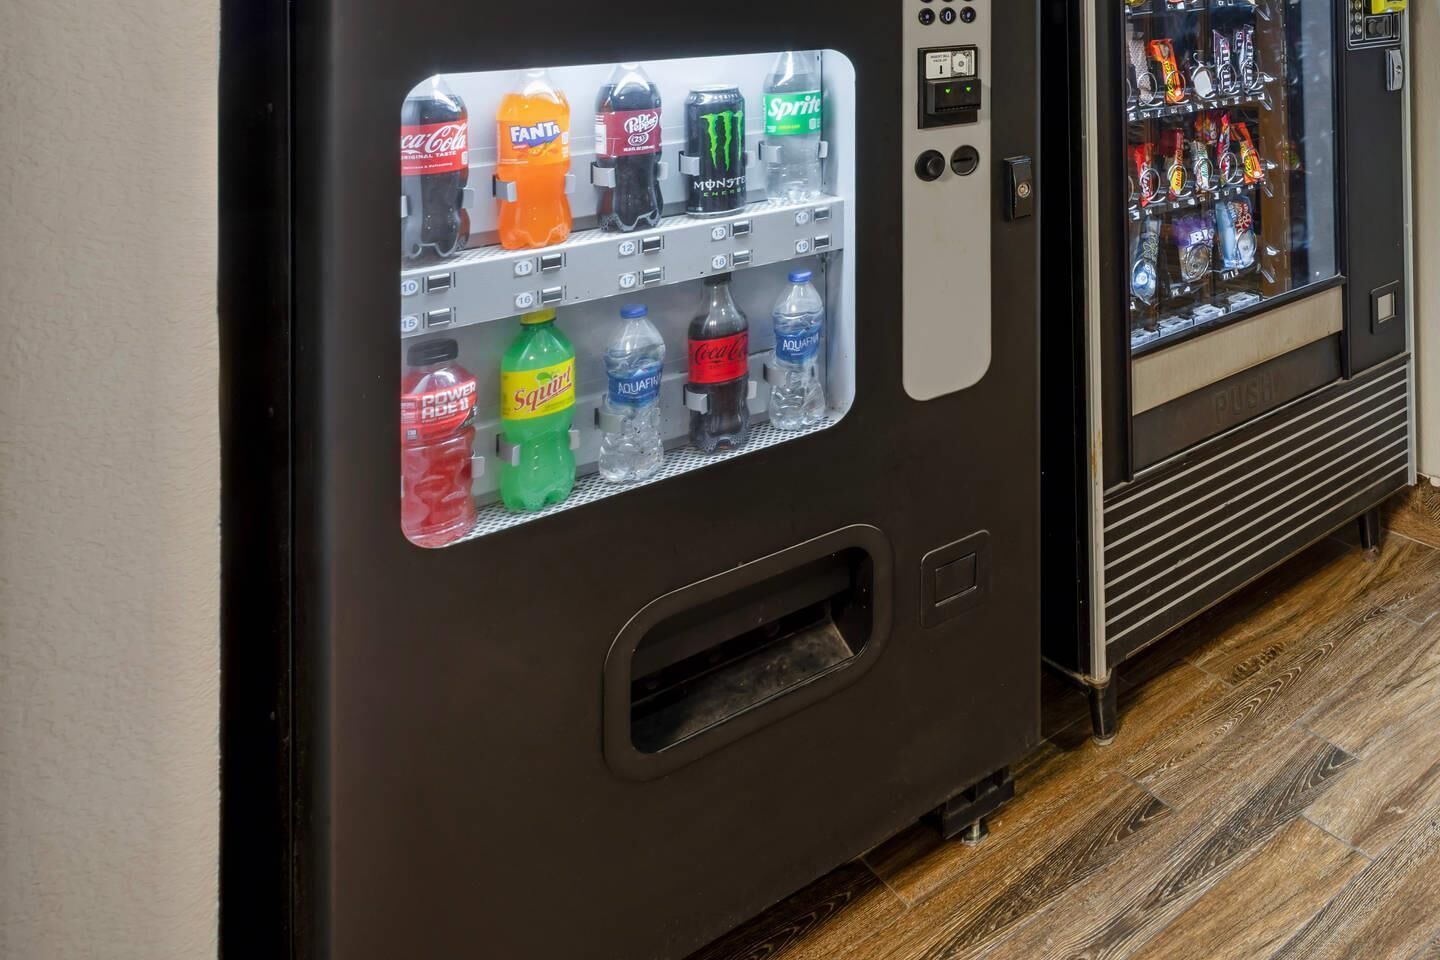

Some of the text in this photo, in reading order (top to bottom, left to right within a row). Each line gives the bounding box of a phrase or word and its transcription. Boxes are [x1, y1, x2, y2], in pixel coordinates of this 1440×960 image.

[945, 11, 952, 22] 0
[510, 121, 561, 143] FANTA
[435, 150, 457, 158] TASTE
[693, 175, 746, 192] MONSTE
[714, 229, 725, 238] 13
[622, 244, 633, 253] 12
[518, 263, 530, 273] 11
[622, 276, 634, 285] 17
[402, 281, 416, 292] 10
[518, 295, 531, 305] 16
[402, 319, 416, 329] 15
[422, 381, 476, 407] POWER
[514, 365, 572, 412] Squirt
[1214, 370, 1275, 425] PUSH
[422, 401, 458, 420] ADE
